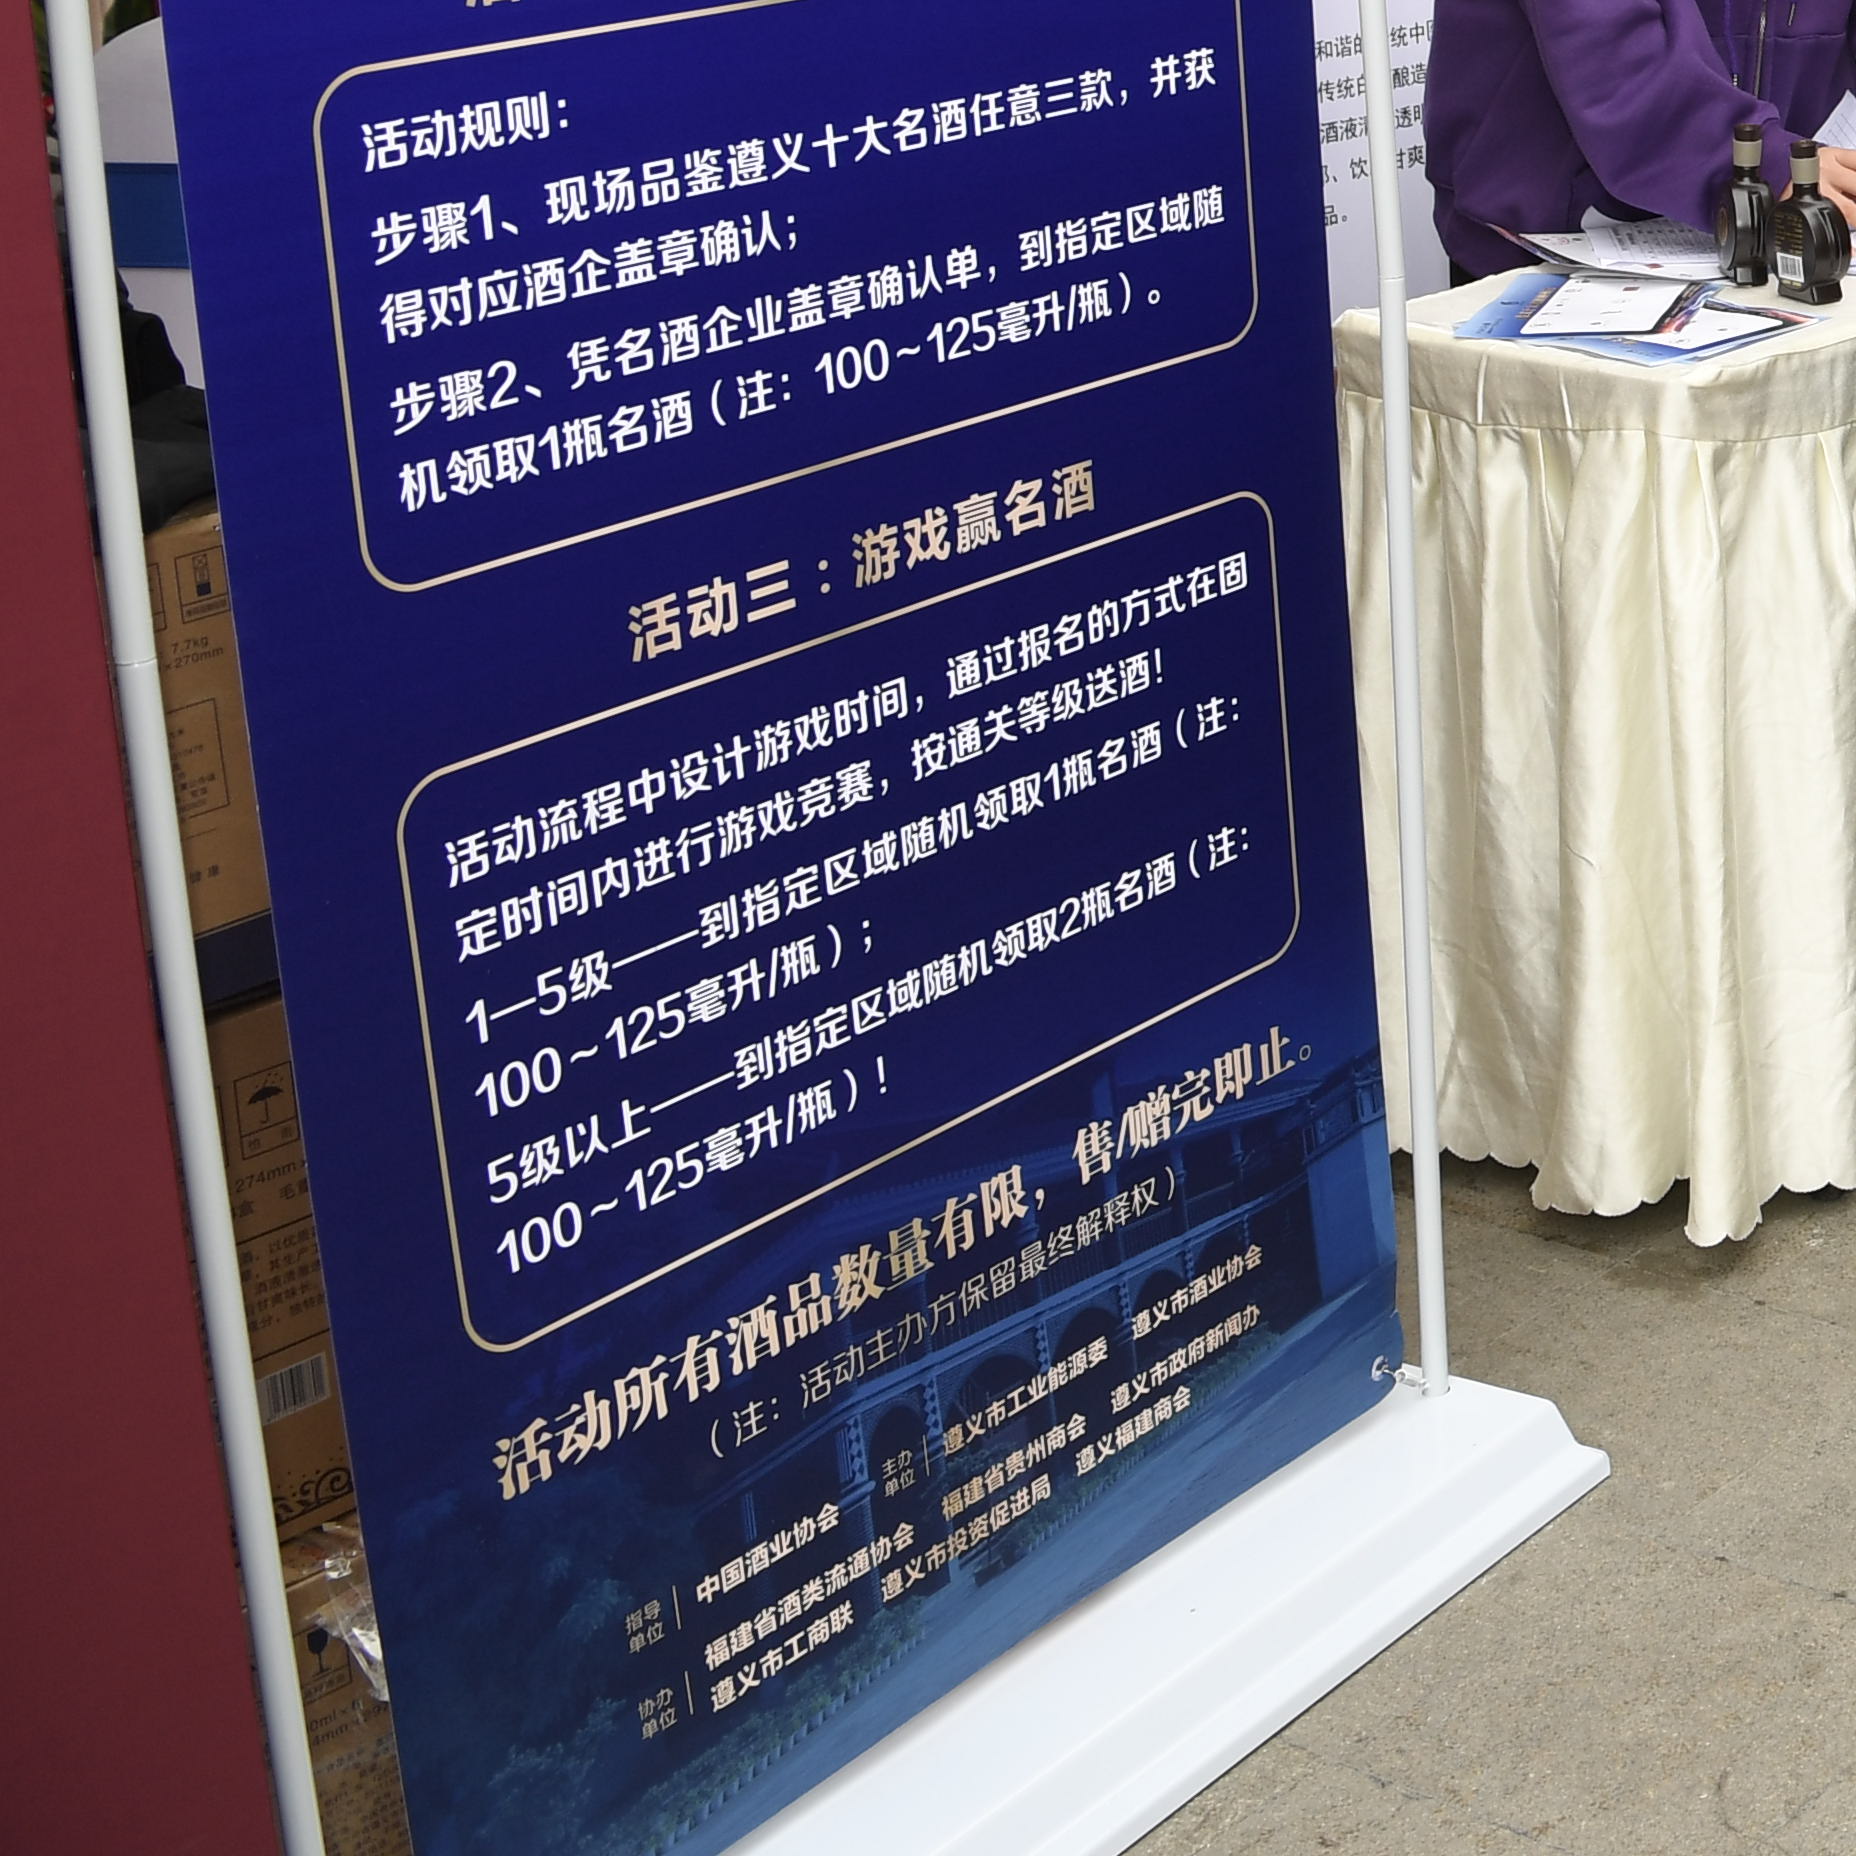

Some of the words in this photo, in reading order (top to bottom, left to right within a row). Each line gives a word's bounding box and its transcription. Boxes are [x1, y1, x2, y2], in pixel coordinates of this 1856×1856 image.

[360, 91, 571, 172] 活动规则：
[627, 460, 1097, 663] 活动三：游戏赢名酒
[1131, 1243, 1264, 1341] 遵义市酒业协会
[695, 1501, 841, 1606] 中国酒业协会
[703, 1521, 916, 1673] 福建省酒类流通协会
[940, 1411, 1088, 1523] 福建省贵州商会
[710, 1603, 855, 1714] 遵义市工商联
[880, 1474, 1054, 1604] 遵义市投资促进局
[1075, 1384, 1193, 1477] 遵义福建商会
